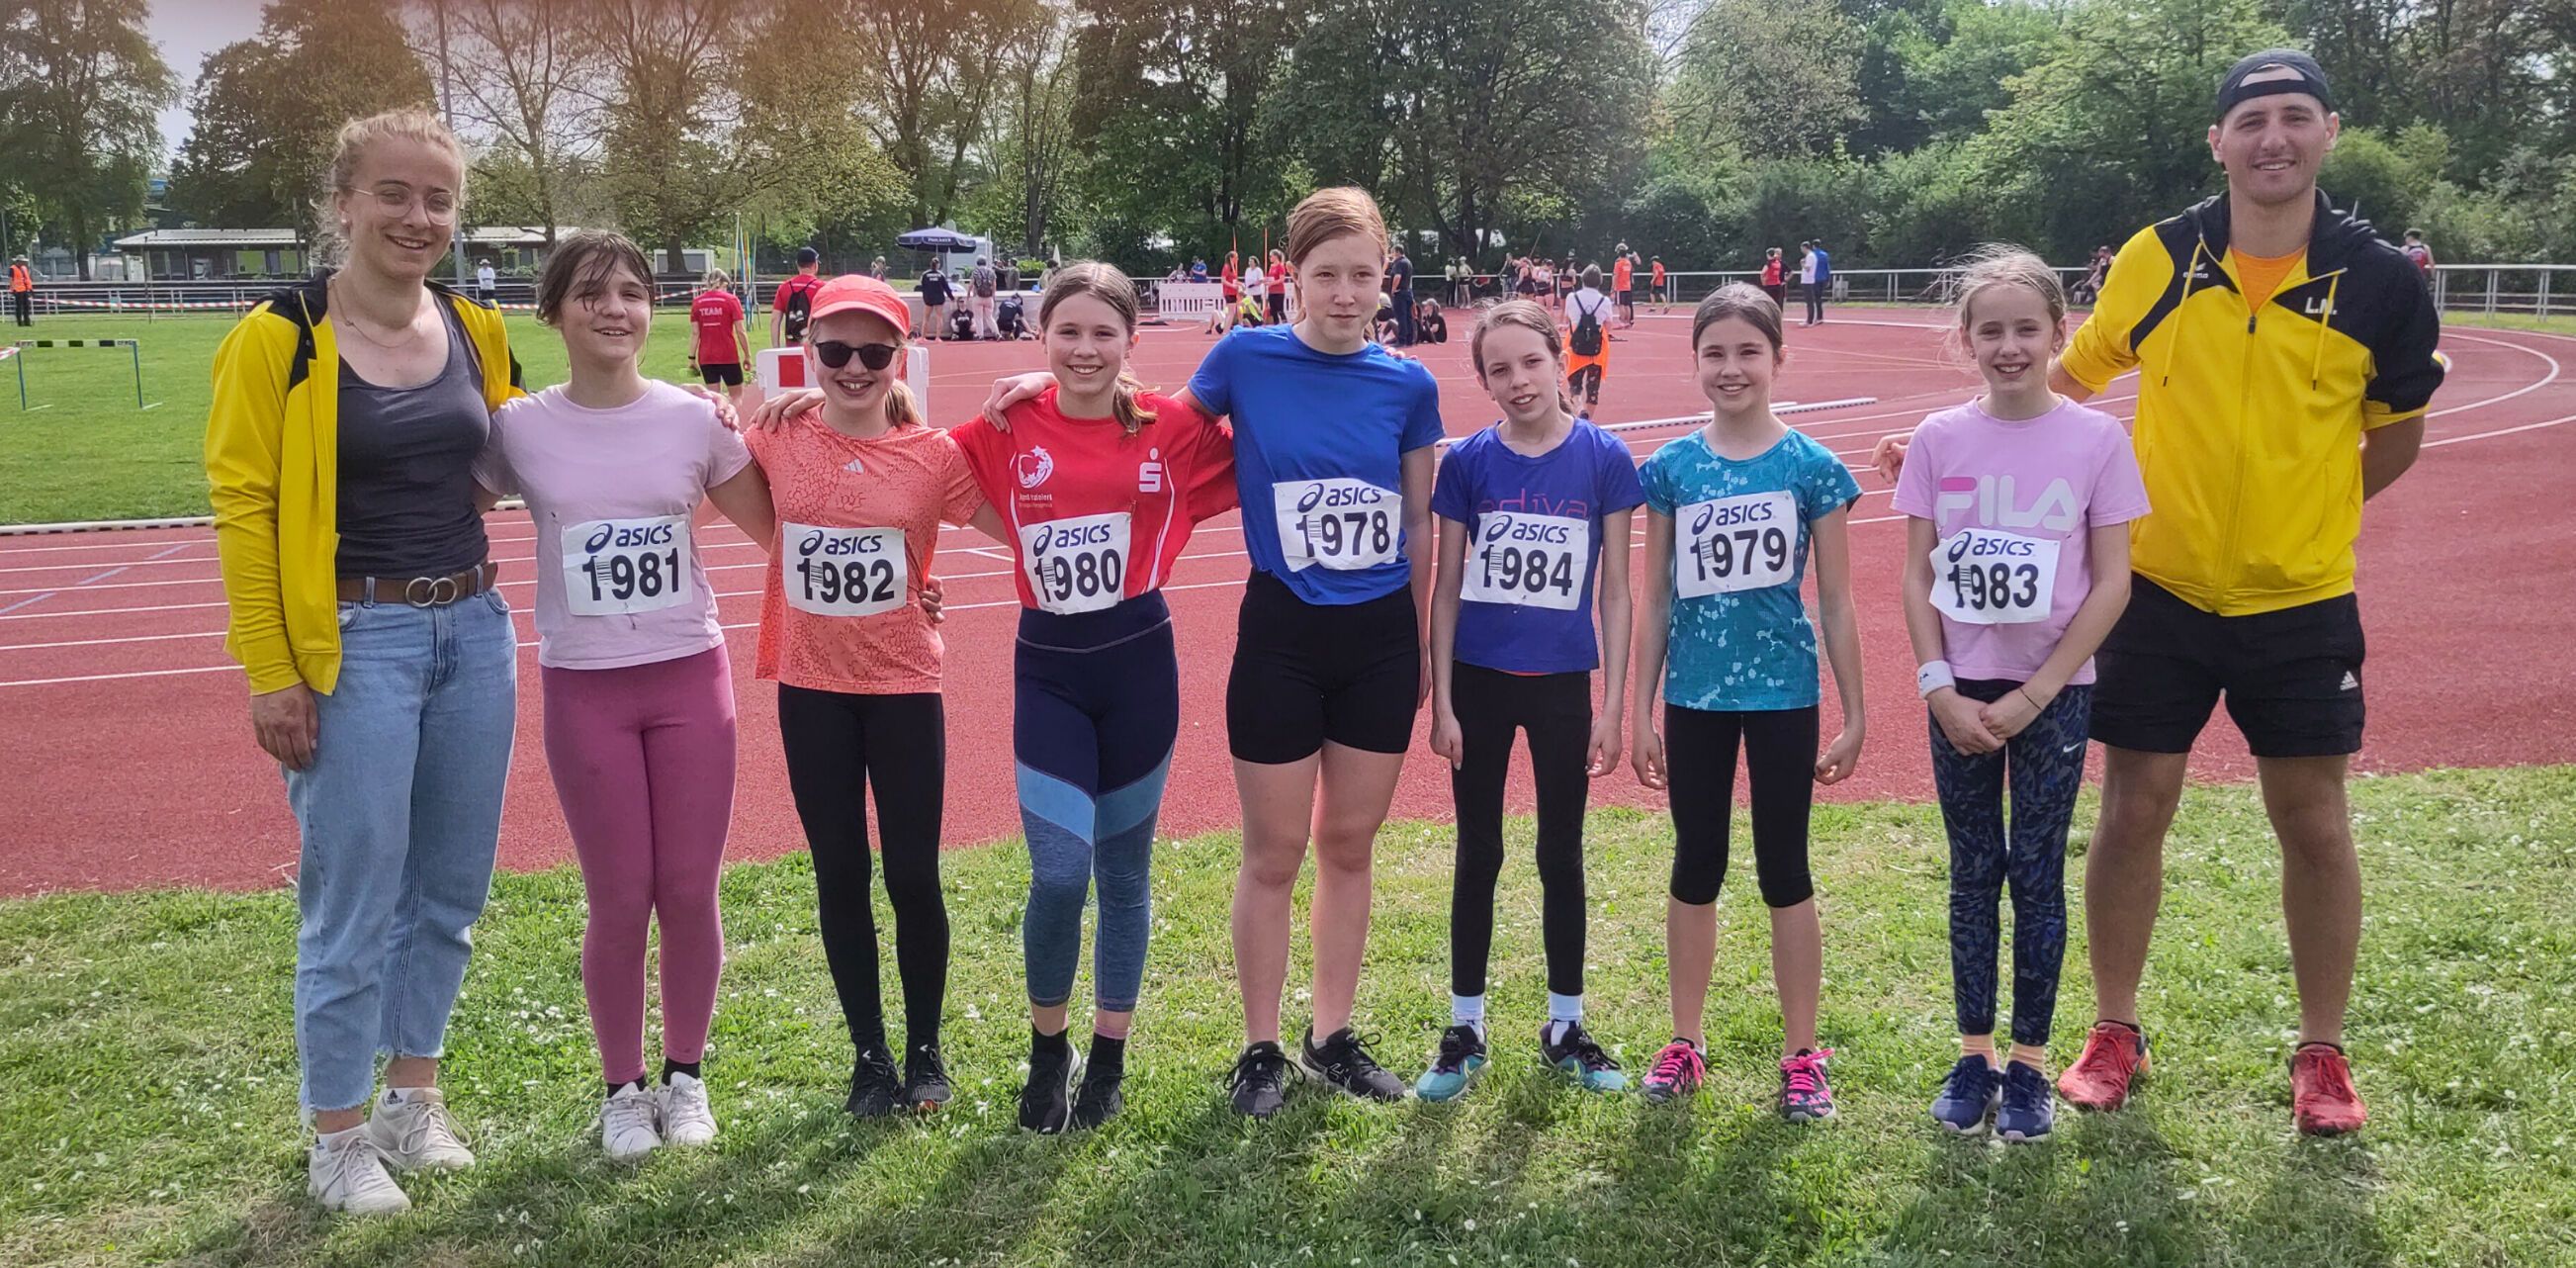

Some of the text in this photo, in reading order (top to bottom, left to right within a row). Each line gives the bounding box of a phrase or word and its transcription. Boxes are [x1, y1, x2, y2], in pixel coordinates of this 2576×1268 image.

[699, 307, 723, 317] TEAM
[1936, 474, 2078, 532] FILA
[1295, 509, 1390, 558] 1978
[1689, 527, 1787, 582] 1979
[581, 547, 679, 601] 1981
[796, 557, 895, 604] 1982
[1033, 548, 1121, 603] 1980
[1479, 544, 1573, 596] 1984
[1947, 562, 2039, 610] 1983
